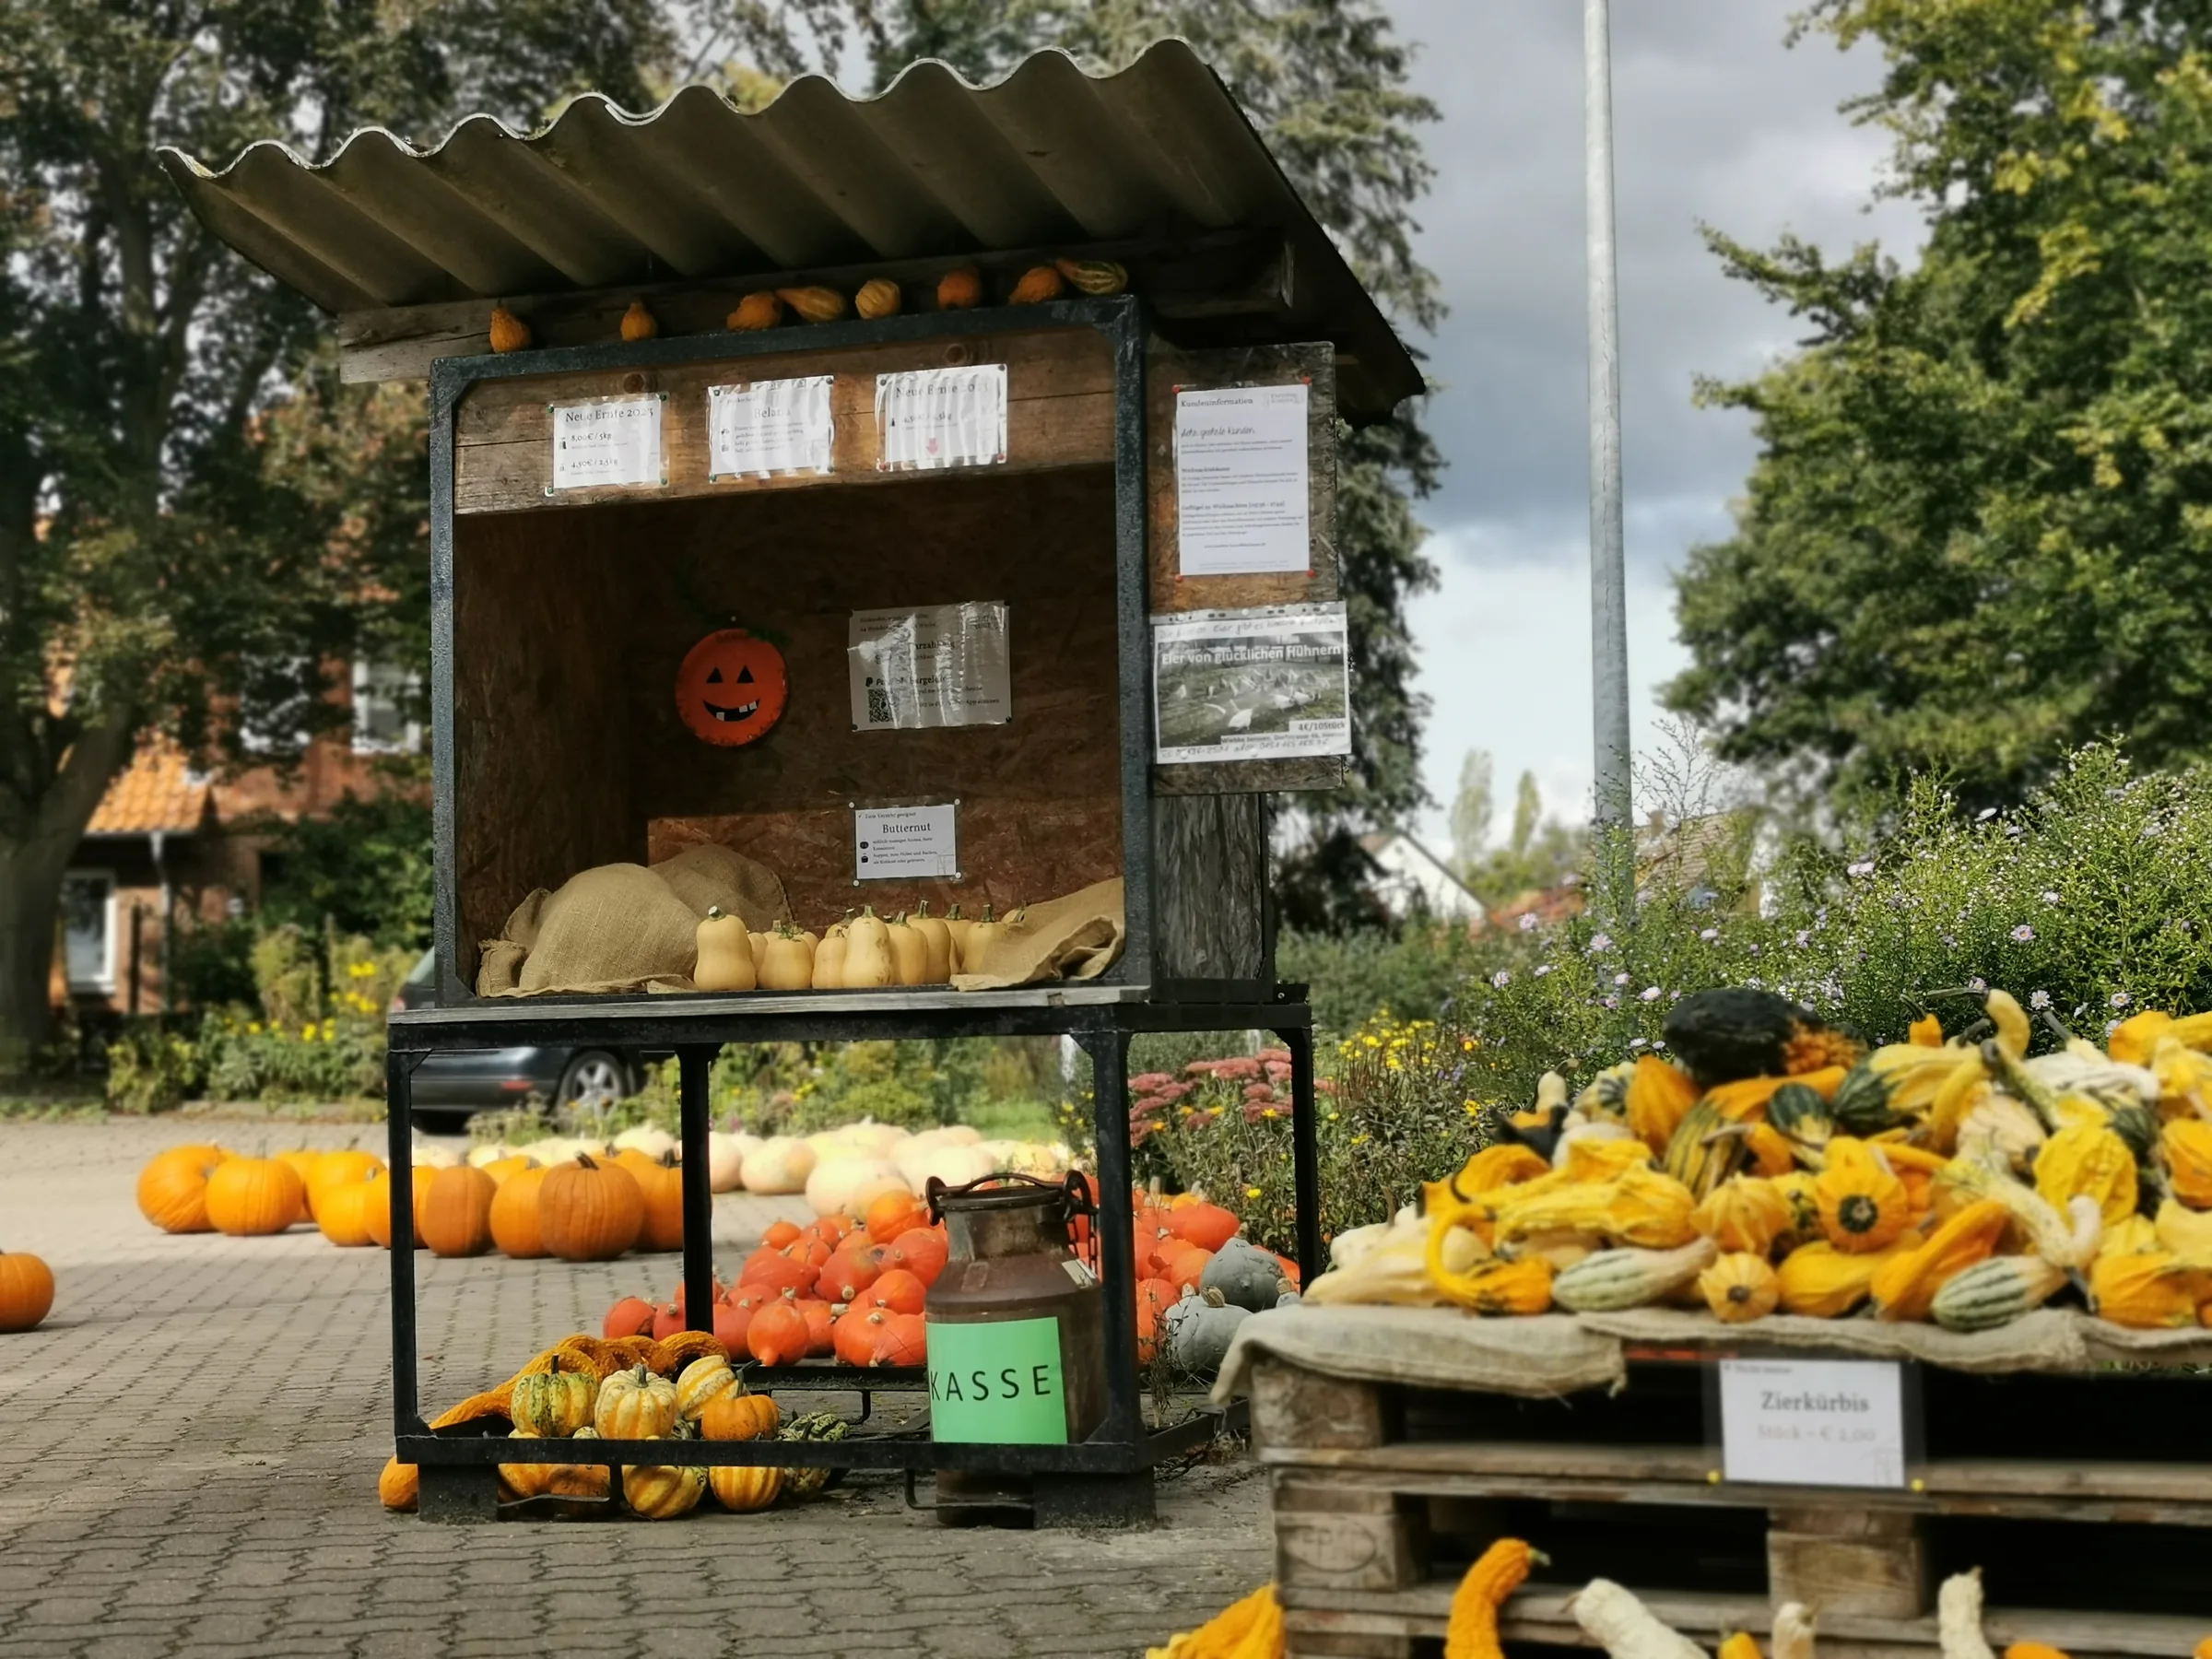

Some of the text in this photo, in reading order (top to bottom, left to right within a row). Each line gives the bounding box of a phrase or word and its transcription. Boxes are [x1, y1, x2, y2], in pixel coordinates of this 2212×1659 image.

[1181, 398, 1253, 407] Kundeninformation
[595, 409, 624, 419] Ernte
[1162, 645, 1341, 665] Eier von glücklichen Hühnern
[882, 823, 931, 834] Butternut
[930, 1365, 1051, 1401] KASSE
[1760, 1390, 1870, 1413] Zierkürbis
